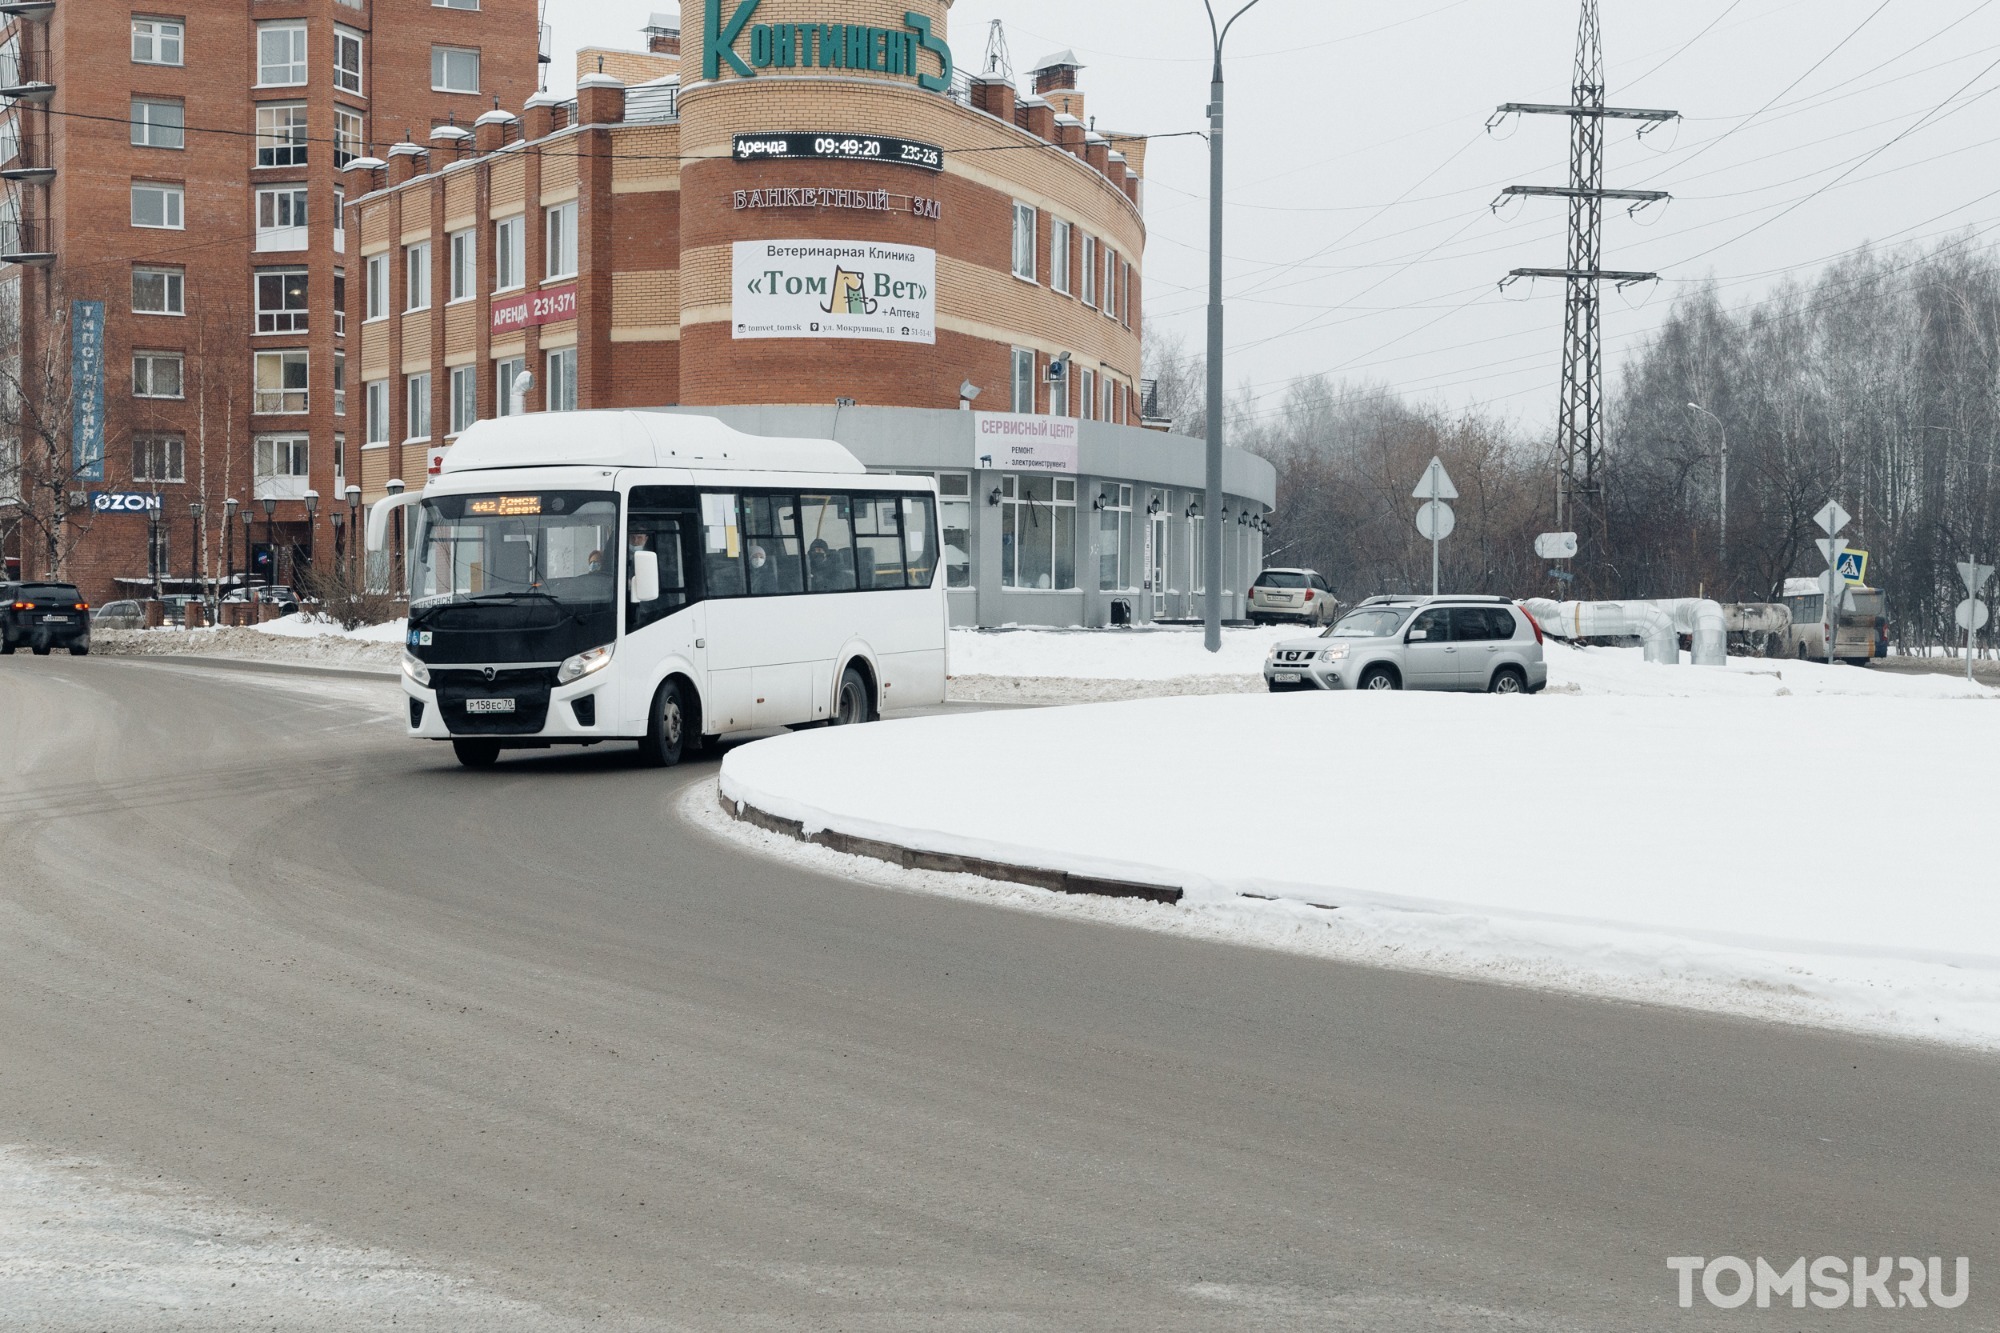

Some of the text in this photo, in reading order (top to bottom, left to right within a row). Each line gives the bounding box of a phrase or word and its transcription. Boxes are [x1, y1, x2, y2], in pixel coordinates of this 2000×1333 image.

[737, 138, 938, 165] Аренда 09:49:20 235-235
[733, 188, 889, 210] БАНКЕТНЫЙ
[767, 245, 915, 263] Ветеринарная Клиника
[494, 292, 576, 326] АРЕНДА 231-371
[748, 323, 802, 332] tomvet_tomsk
[982, 420, 1075, 439] СЕРВИСНЫЙ ЦЕНТР
[95, 494, 160, 509] OZON
[472, 501, 496, 511] 442
